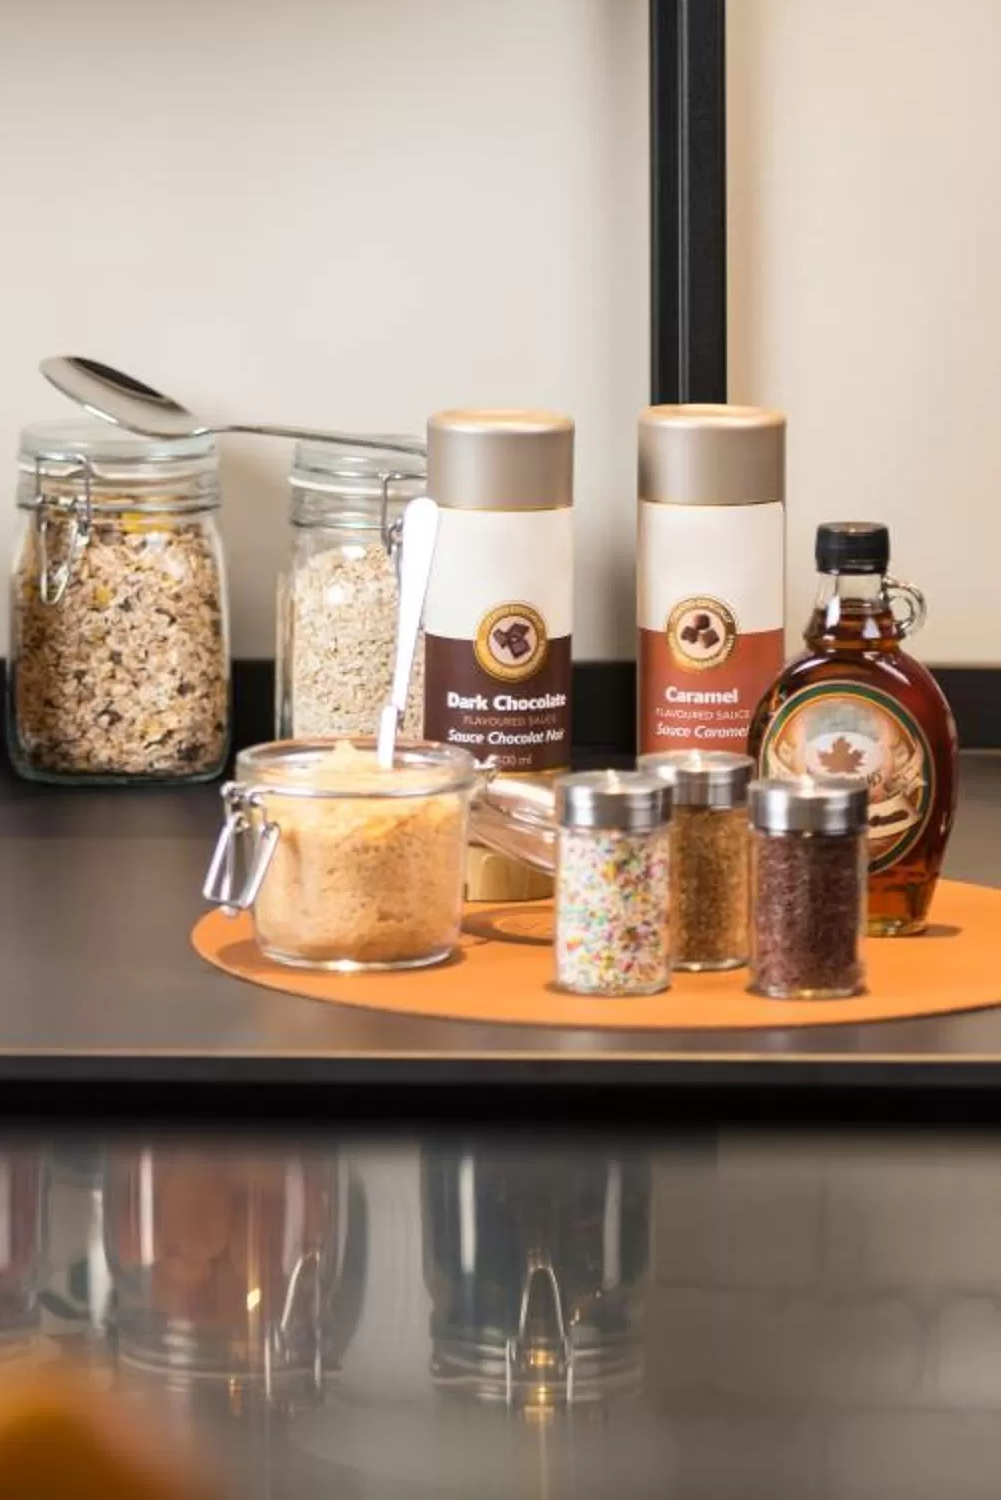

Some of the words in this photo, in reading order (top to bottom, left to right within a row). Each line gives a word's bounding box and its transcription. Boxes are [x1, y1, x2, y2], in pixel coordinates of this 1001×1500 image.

[446, 691, 488, 711] Dark
[493, 693, 567, 711] Chocolate
[665, 685, 739, 704] Caramel
[463, 714, 526, 727] FLAVOURED
[655, 707, 714, 720] FLAVOURED
[715, 708, 752, 720] SAUCE
[447, 728, 484, 743] Sauce
[487, 730, 544, 745] Chocolat
[654, 721, 691, 738] Sauce
[694, 724, 750, 739] Caramel
[518, 754, 533, 766] ml
